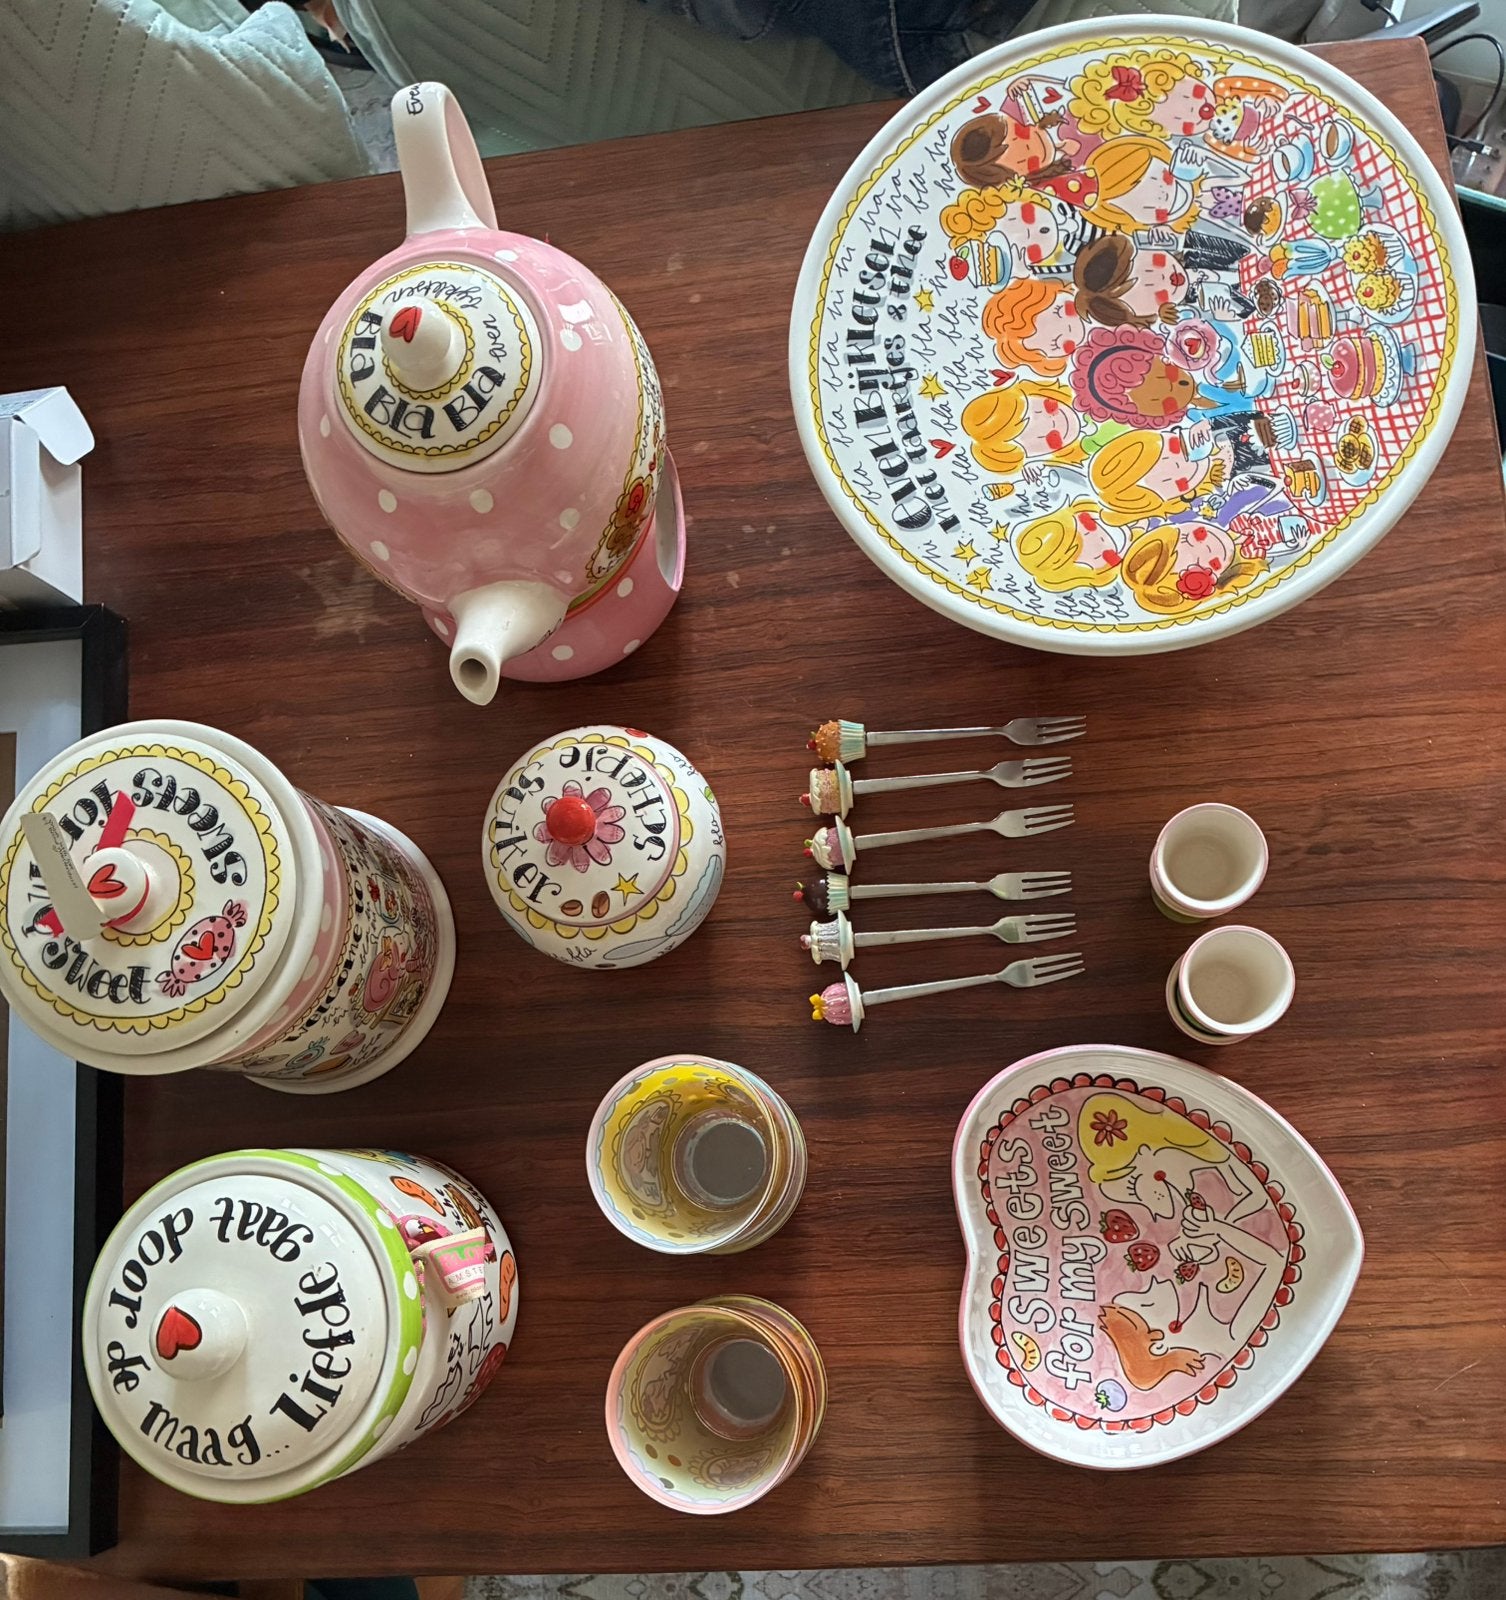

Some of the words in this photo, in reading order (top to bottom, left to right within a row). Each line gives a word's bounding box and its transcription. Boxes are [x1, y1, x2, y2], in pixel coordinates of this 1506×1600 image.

[889, 224, 928, 297] thee
[887, 304, 907, 321] &
[822, 331, 841, 392] bla
[363, 385, 436, 439] Bla
[442, 365, 507, 432] Bla
[828, 404, 854, 448] bla
[852, 461, 882, 506] bla
[915, 468, 960, 533] met
[208, 1196, 315, 1264] gaat
[108, 1206, 195, 1330] door
[1058, 1235, 1108, 1303] my
[106, 1339, 152, 1395] de
[269, 1260, 356, 1433] Liefde
[1044, 1304, 1096, 1391] for
